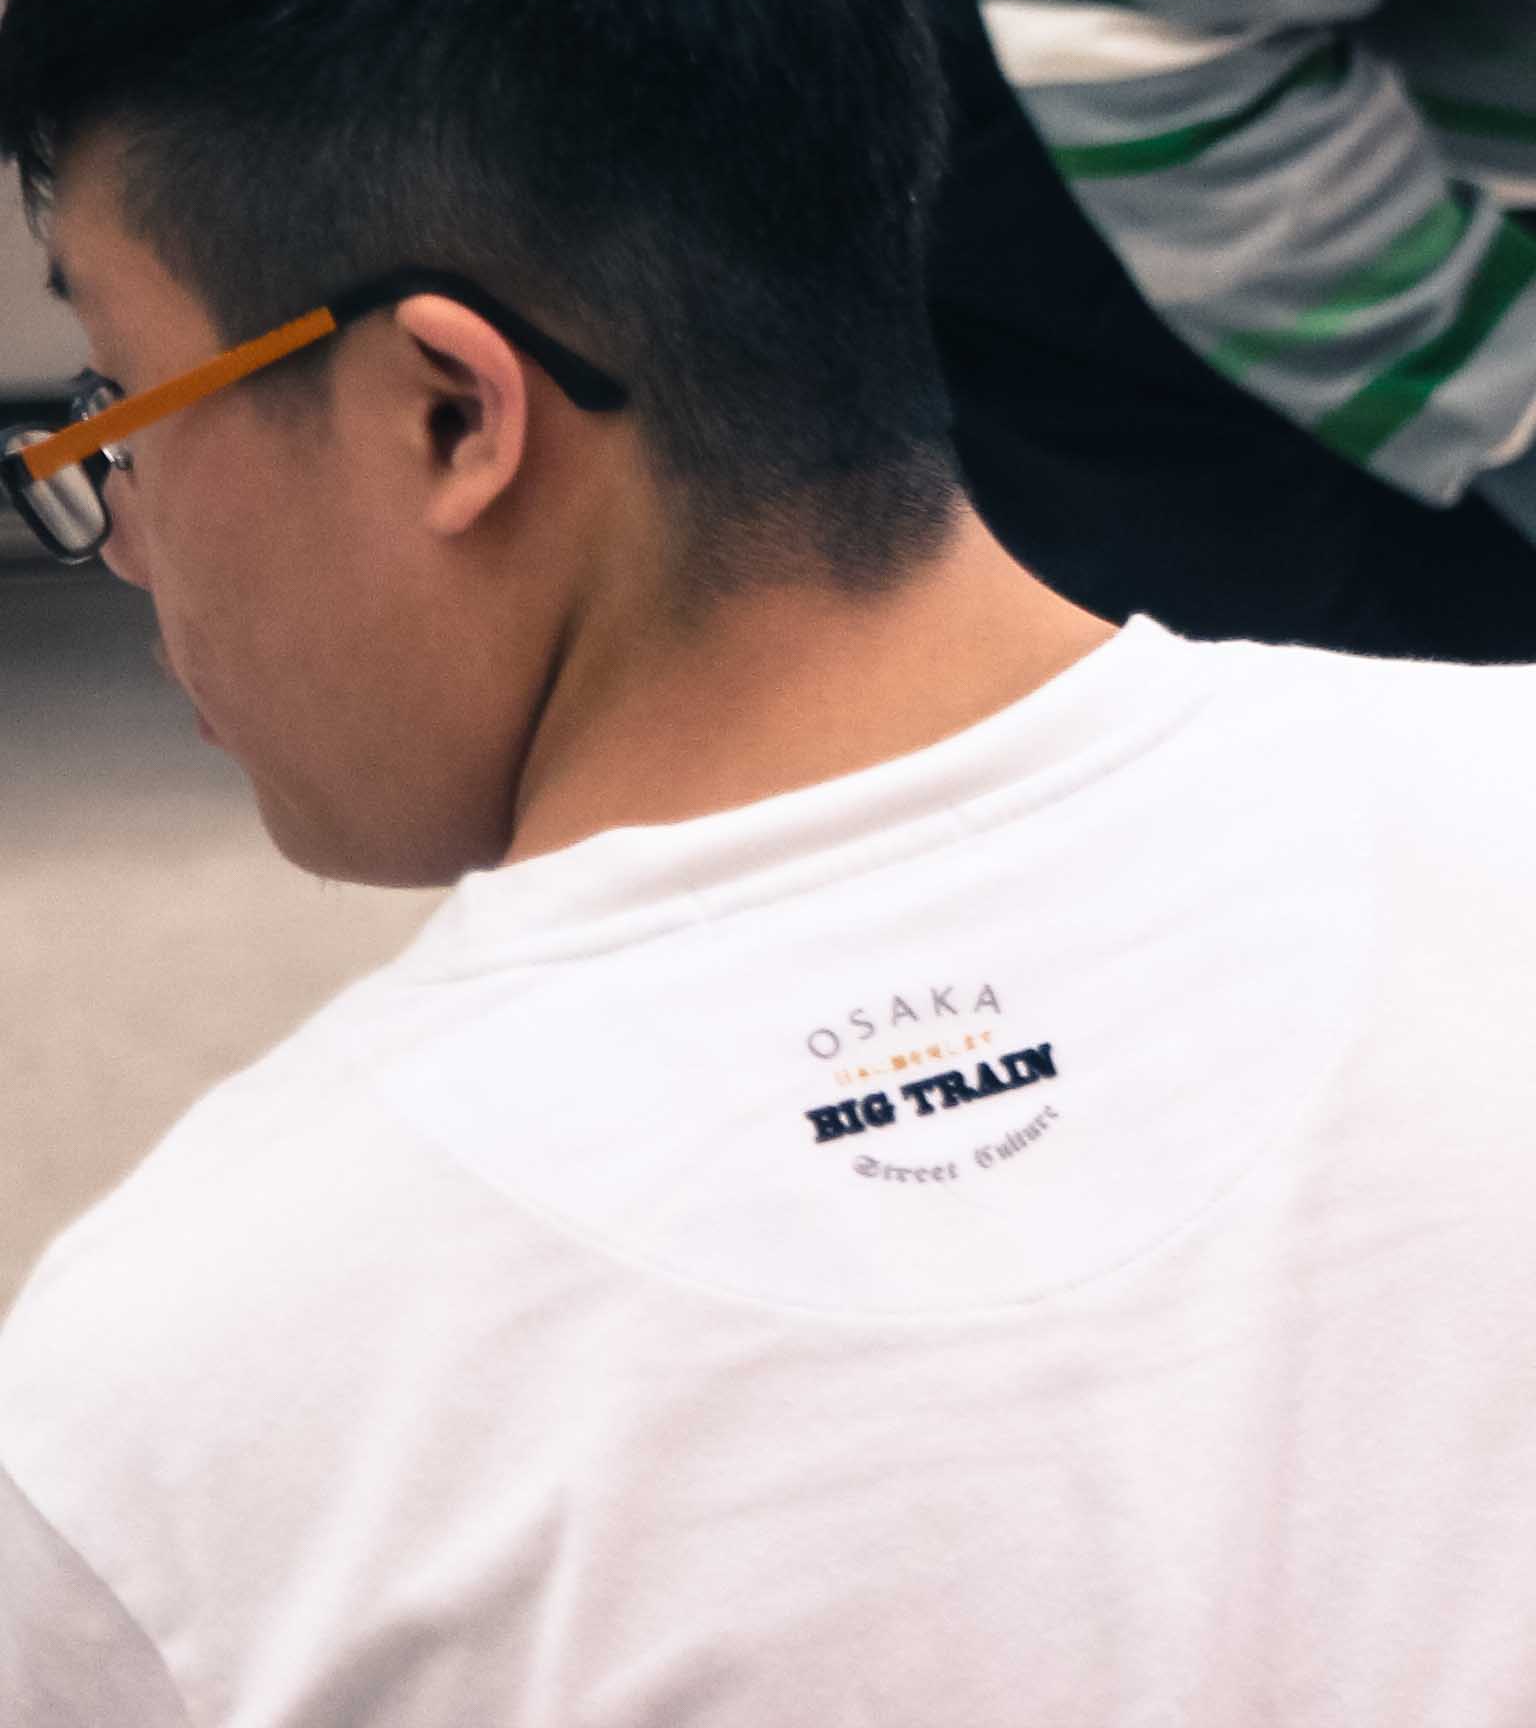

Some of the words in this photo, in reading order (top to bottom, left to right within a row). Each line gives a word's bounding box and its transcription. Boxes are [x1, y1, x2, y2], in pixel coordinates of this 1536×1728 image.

[807, 984, 1002, 1059] OSAKA
[805, 1091, 896, 1144] BIG
[900, 1042, 1058, 1117] TRAIN
